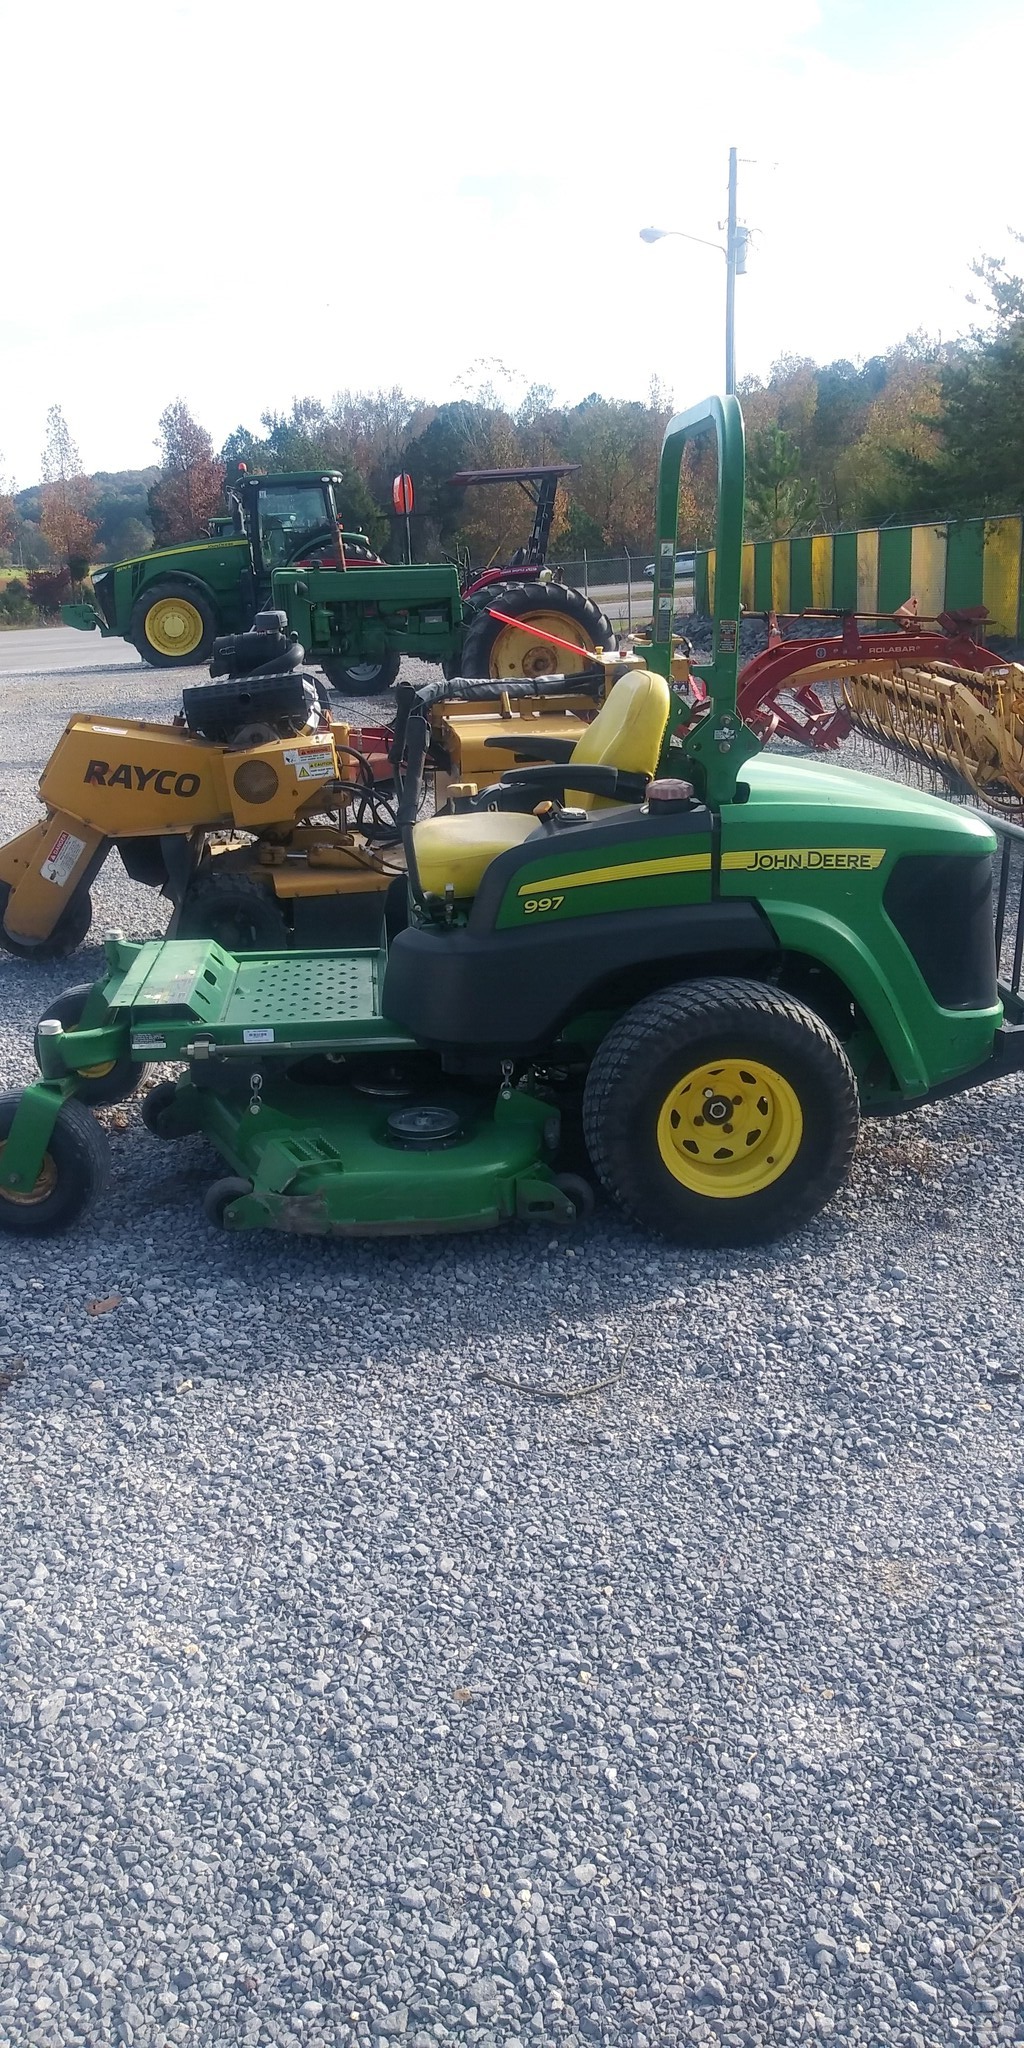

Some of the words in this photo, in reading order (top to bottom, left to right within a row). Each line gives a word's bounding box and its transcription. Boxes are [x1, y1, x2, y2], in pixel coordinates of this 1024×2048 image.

[868, 645, 916, 654] ROLABAR
[83, 760, 201, 797] RAYCO
[747, 852, 802, 869] JOHN
[808, 851, 871, 868] DEERE
[523, 895, 566, 914] 997
